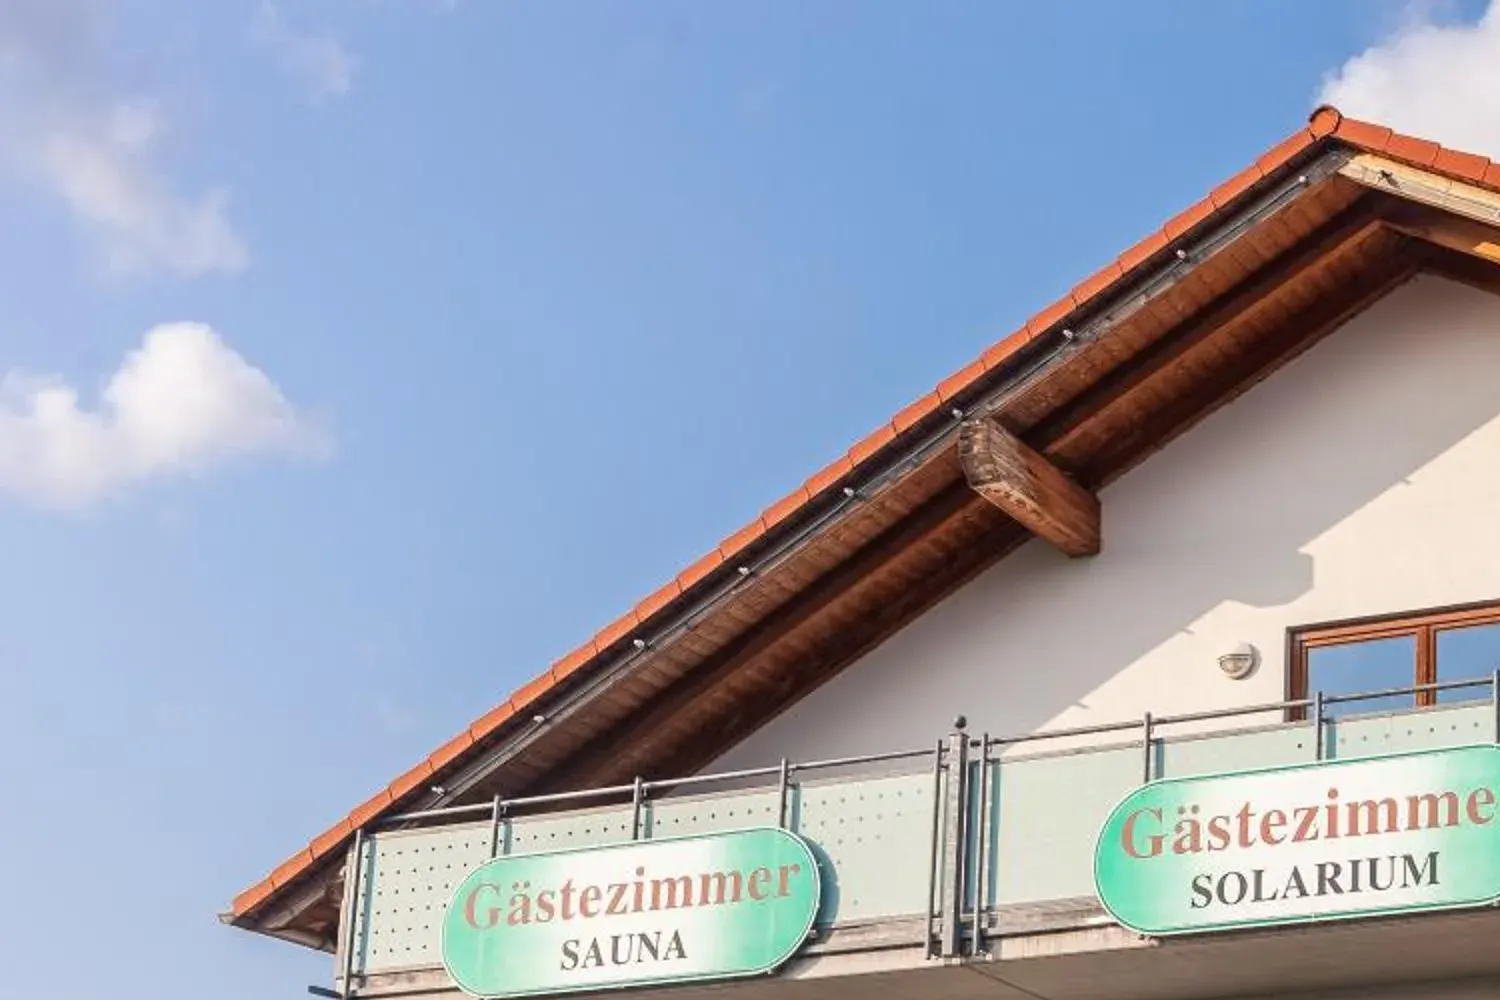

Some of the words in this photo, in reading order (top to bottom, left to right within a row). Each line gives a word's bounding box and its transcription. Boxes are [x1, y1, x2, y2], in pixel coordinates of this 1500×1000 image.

[463, 864, 801, 930] Gästezimmer
[1190, 851, 1441, 909] SOLARIUM
[560, 929, 688, 971] SAUNA
